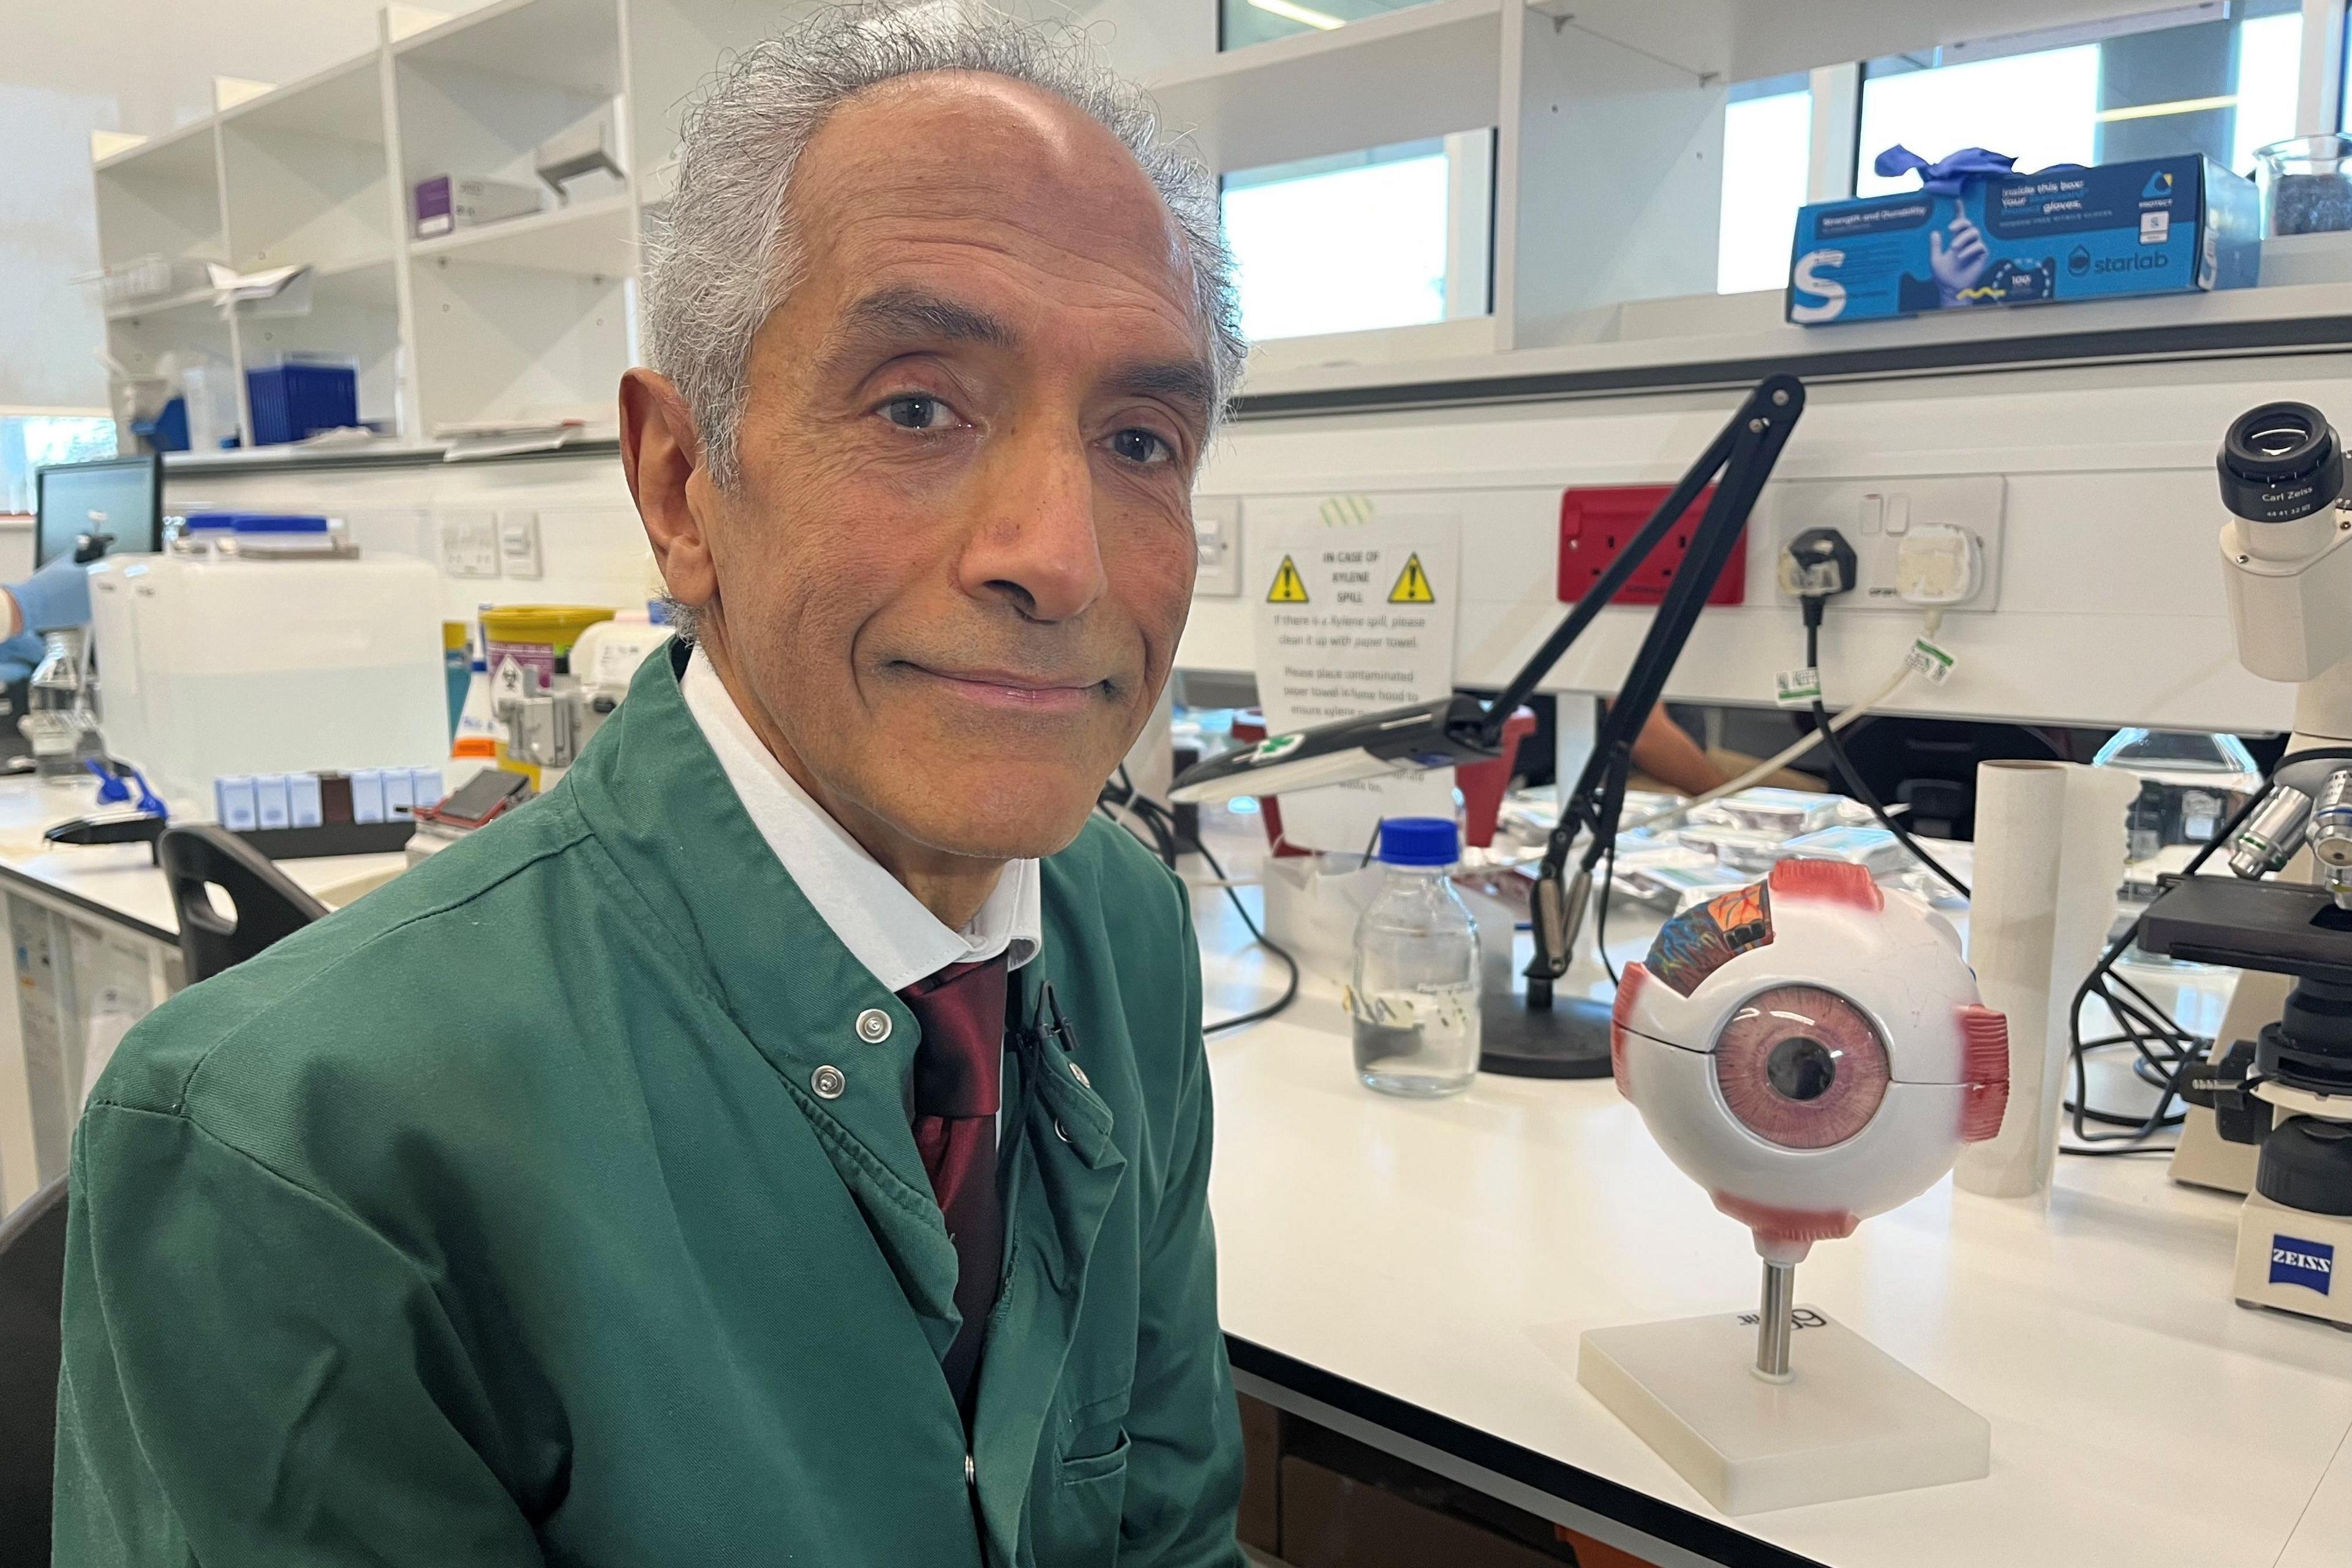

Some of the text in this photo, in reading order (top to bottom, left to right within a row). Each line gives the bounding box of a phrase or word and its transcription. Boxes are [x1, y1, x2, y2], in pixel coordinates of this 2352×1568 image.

[2002, 185, 2035, 197] Inside
[2037, 182, 2058, 194] this
[1861, 211, 1880, 222] and
[2094, 250, 2168, 274] starlab
[2262, 487, 2313, 502] Carl Zeiss
[1323, 551, 1379, 562] IN CASE OF
[1332, 571, 1370, 582] XYLENE
[1337, 592, 1363, 603] SPILL
[1283, 614, 1309, 626] there
[1312, 616, 1318, 625] is
[1330, 615, 1364, 628] Xylene
[1392, 616, 1425, 628] please
[1279, 635, 1303, 646] clean
[1306, 635, 1312, 645] it
[1315, 636, 1327, 647] up
[1330, 636, 1351, 646] with
[1354, 637, 1382, 649] paper
[1284, 665, 1414, 682] Please place contaminated
[1284, 687, 1308, 697] paper
[1311, 687, 1339, 698] towel
[1350, 688, 1376, 700] fume
[1378, 689, 1404, 702] hood
[1407, 691, 1419, 702] to
[1291, 706, 1321, 716] ensure
[1324, 706, 1355, 718] xylene
[2272, 1248, 2331, 1273] ZEISS
